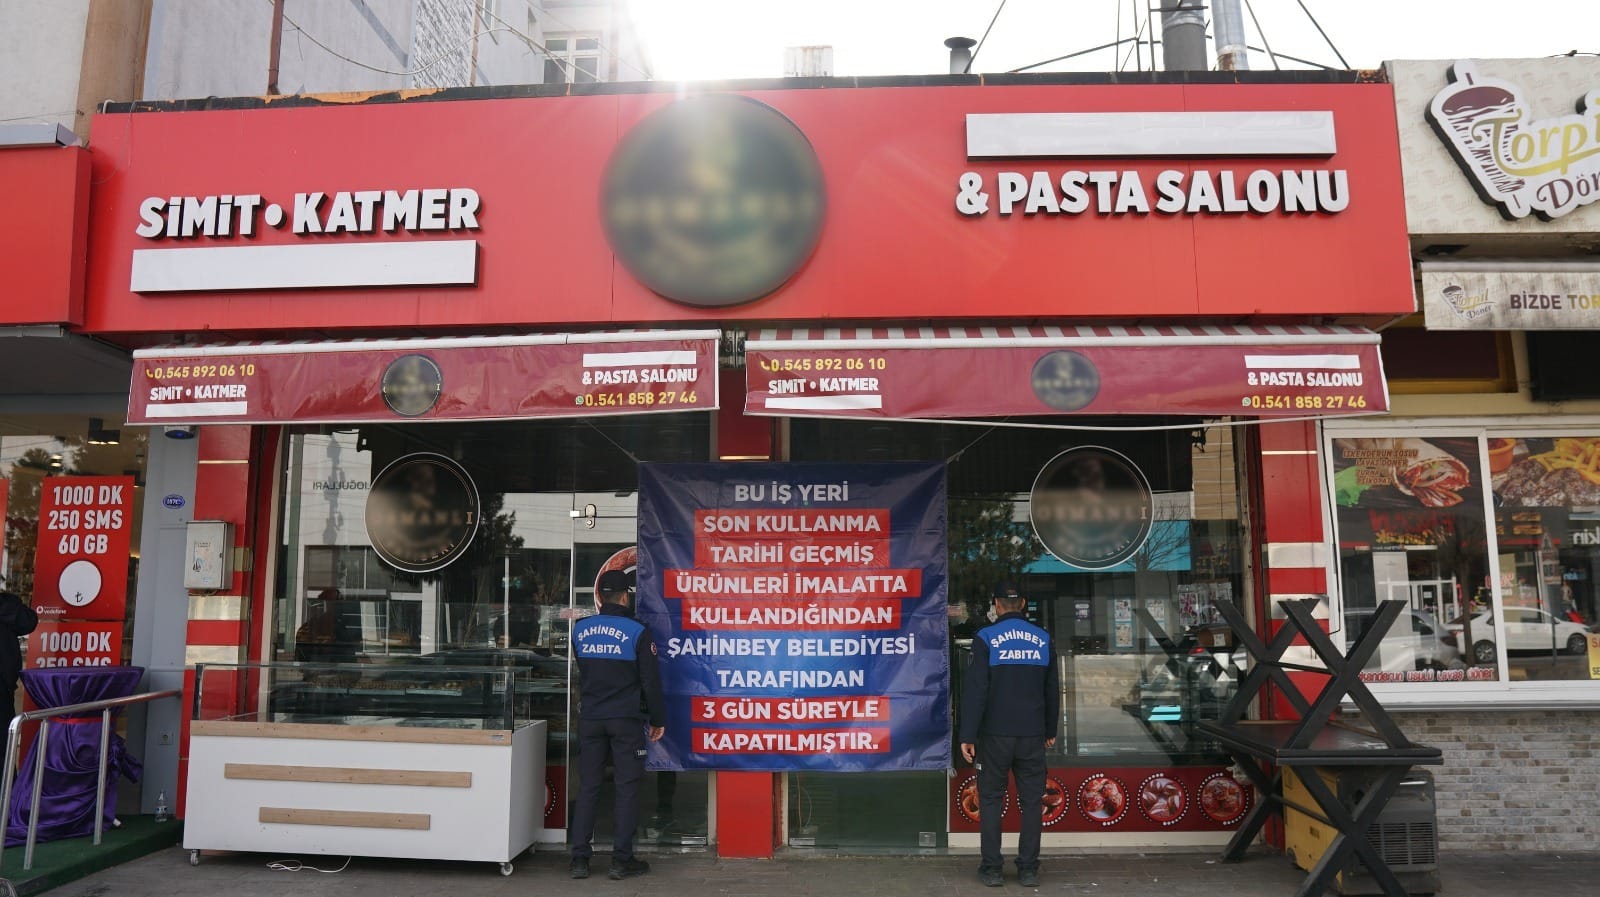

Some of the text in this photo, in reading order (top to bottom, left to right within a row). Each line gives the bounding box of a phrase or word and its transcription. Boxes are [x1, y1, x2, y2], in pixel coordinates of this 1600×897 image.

[955, 169, 1349, 215] & PASTA SALONU
[293, 188, 480, 233] KATMER
[1510, 290, 1562, 310] BİZDE
[154, 364, 255, 379] 0.545 892 06 10
[770, 357, 886, 372] 0.545 892 06 10
[582, 368, 698, 385] & PASTA SALONU
[819, 377, 879, 392] KATMER
[1247, 371, 1363, 387] & PASTA SALONU
[194, 384, 247, 399] KATMER
[585, 390, 697, 407] 0.541 858 27 46
[1251, 395, 1367, 409] 0.541 858 27 46
[53, 485, 124, 506] 1000 DK
[735, 480, 849, 504] BU İŞ YERİ
[48, 509, 123, 530] 250 SMS
[703, 515, 881, 533] SON KULLANMA
[58, 534, 108, 554] 60 GB
[710, 542, 874, 566] TARİHİ GEÇMİŞ
[676, 571, 907, 594] ÜRÜNLERİ İMALATTA
[690, 603, 893, 626] KULLANDIĞINDAN
[40, 631, 112, 652] 1000 DK
[578, 624, 629, 643] ŞAHİNBEY
[990, 628, 1046, 648] ŞAHİNBEY
[582, 643, 622, 655] ZABITA
[667, 633, 915, 658] ŞAHİNBEY BELEDİYESİ
[998, 649, 1041, 660] ZABITA
[717, 669, 864, 689] TARAFINDAN
[702, 698, 879, 720] 3 GÜN SÜREYLE
[703, 732, 879, 753] KAPATILMIŞTIR.
